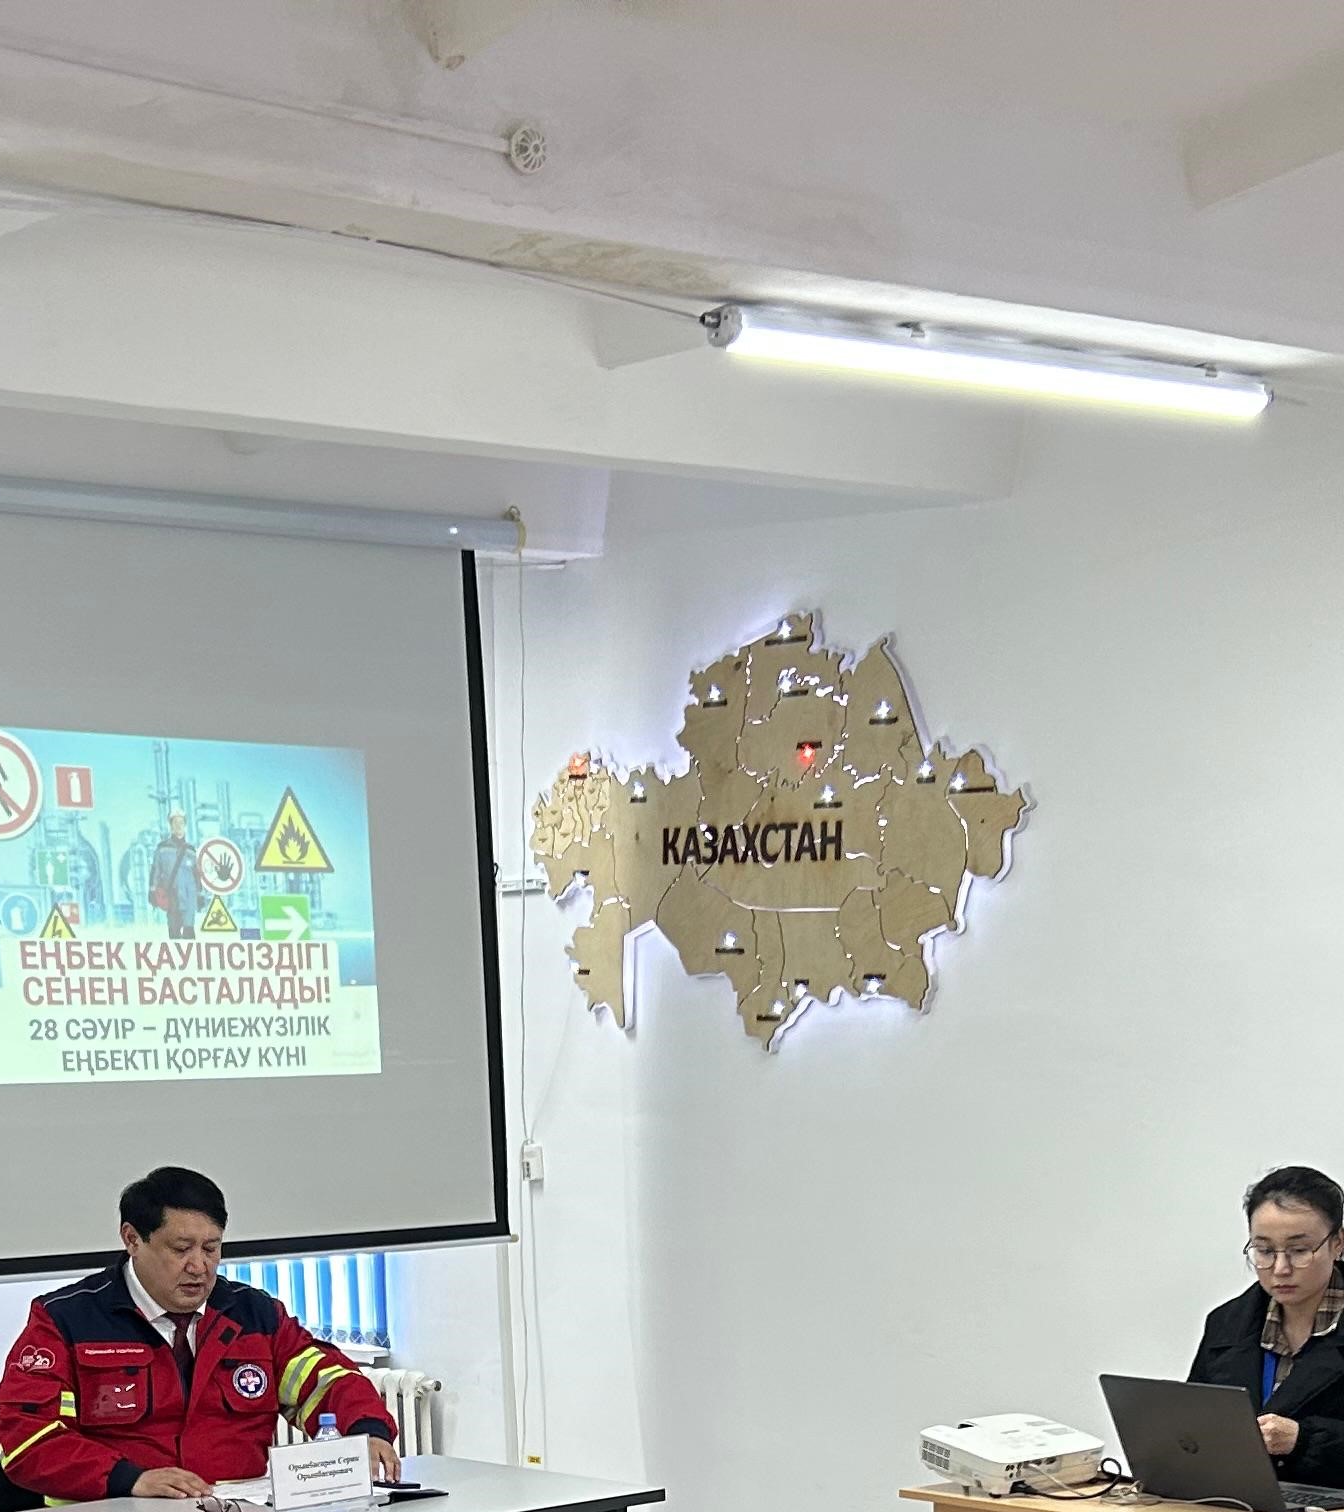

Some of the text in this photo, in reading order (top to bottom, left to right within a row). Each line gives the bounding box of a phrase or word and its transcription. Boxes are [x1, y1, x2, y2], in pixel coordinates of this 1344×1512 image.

[661, 820, 843, 866] КАЗАХСТАН
[19, 941, 329, 976] ЕҢБЕК ҚАУІПСІЗДІГІ
[22, 977, 331, 1009] СЕНЕН БАСТАЛАДЫ!
[29, 1019, 58, 1040] 28
[65, 1018, 135, 1040] СӘУІР
[163, 1016, 331, 1043] ДҮНИЕЖҮЗІЛІК
[62, 1046, 306, 1075] ЕҢБЕКТІ ҚОРҒАУ КҮНІ
